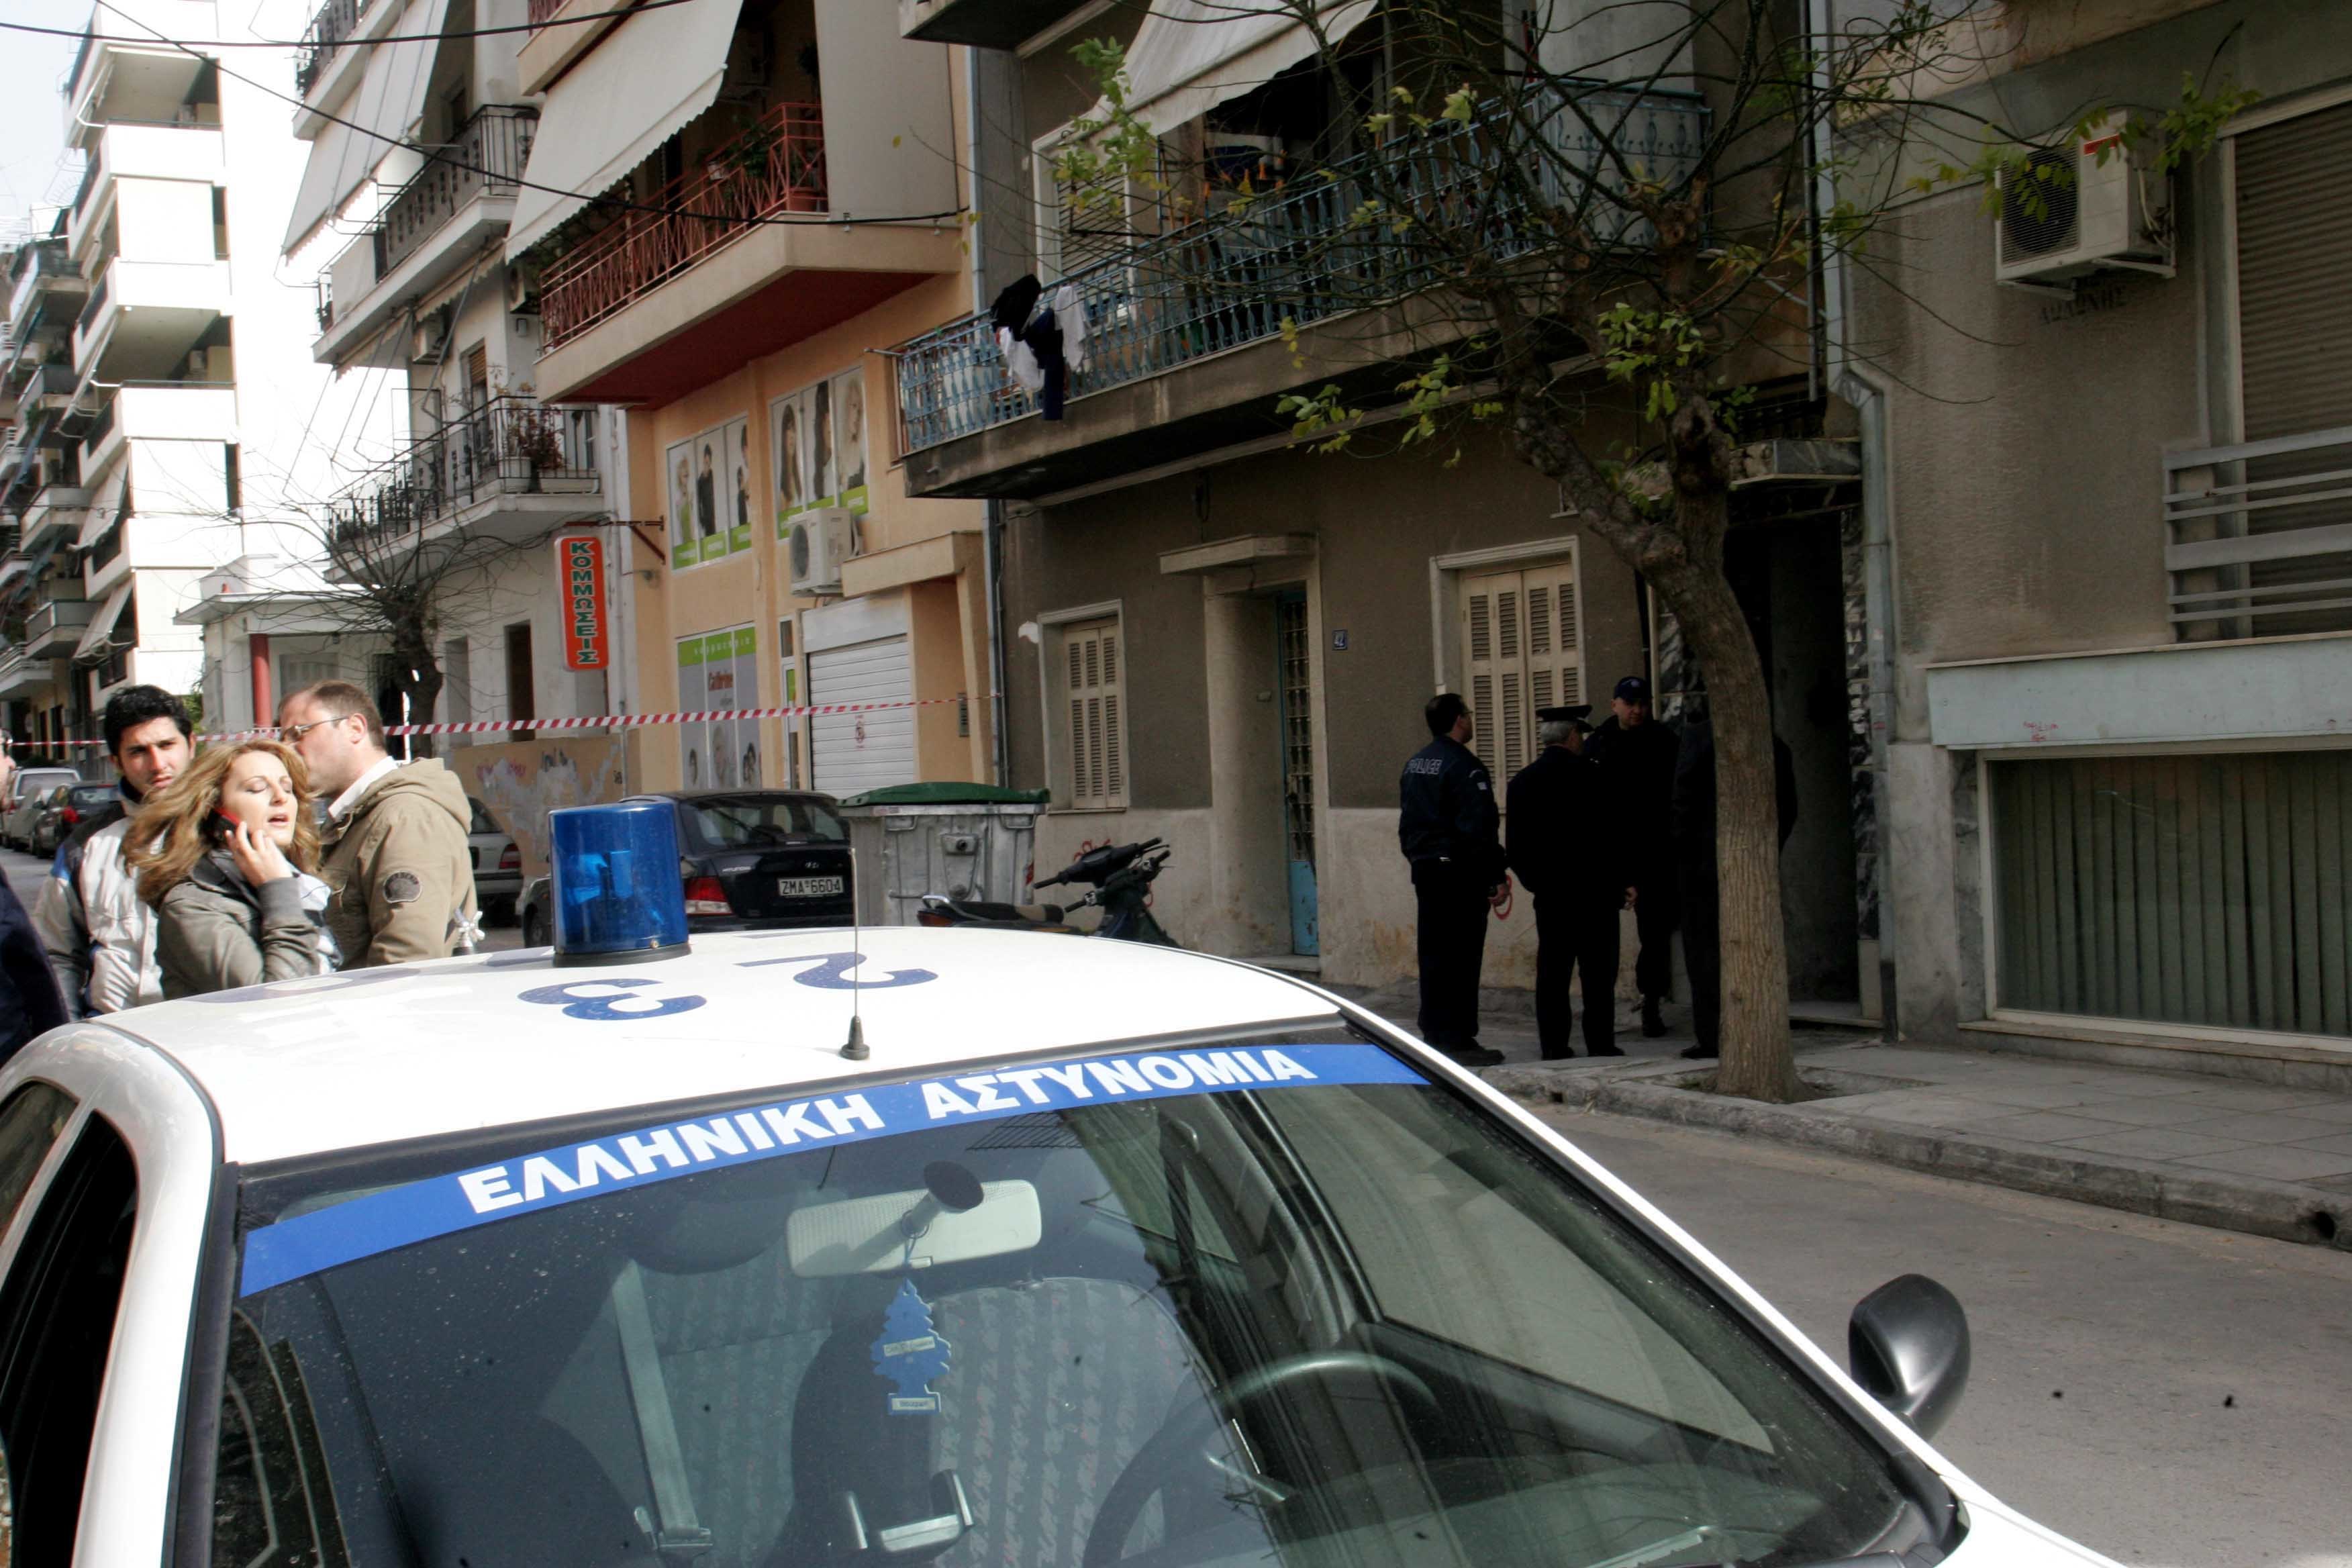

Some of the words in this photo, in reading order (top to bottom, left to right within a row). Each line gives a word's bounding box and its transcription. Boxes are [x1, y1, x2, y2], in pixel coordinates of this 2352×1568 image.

[571, 541, 599, 664] ΚΟΜΜΩΣΕΙΣ
[1405, 758, 1442, 775] POLICE
[457, 1093, 885, 1214] ΕΛΛΗΝΙΚΗ
[921, 1049, 1318, 1120] ΑΣΤΥΝΟΜΙΑ
